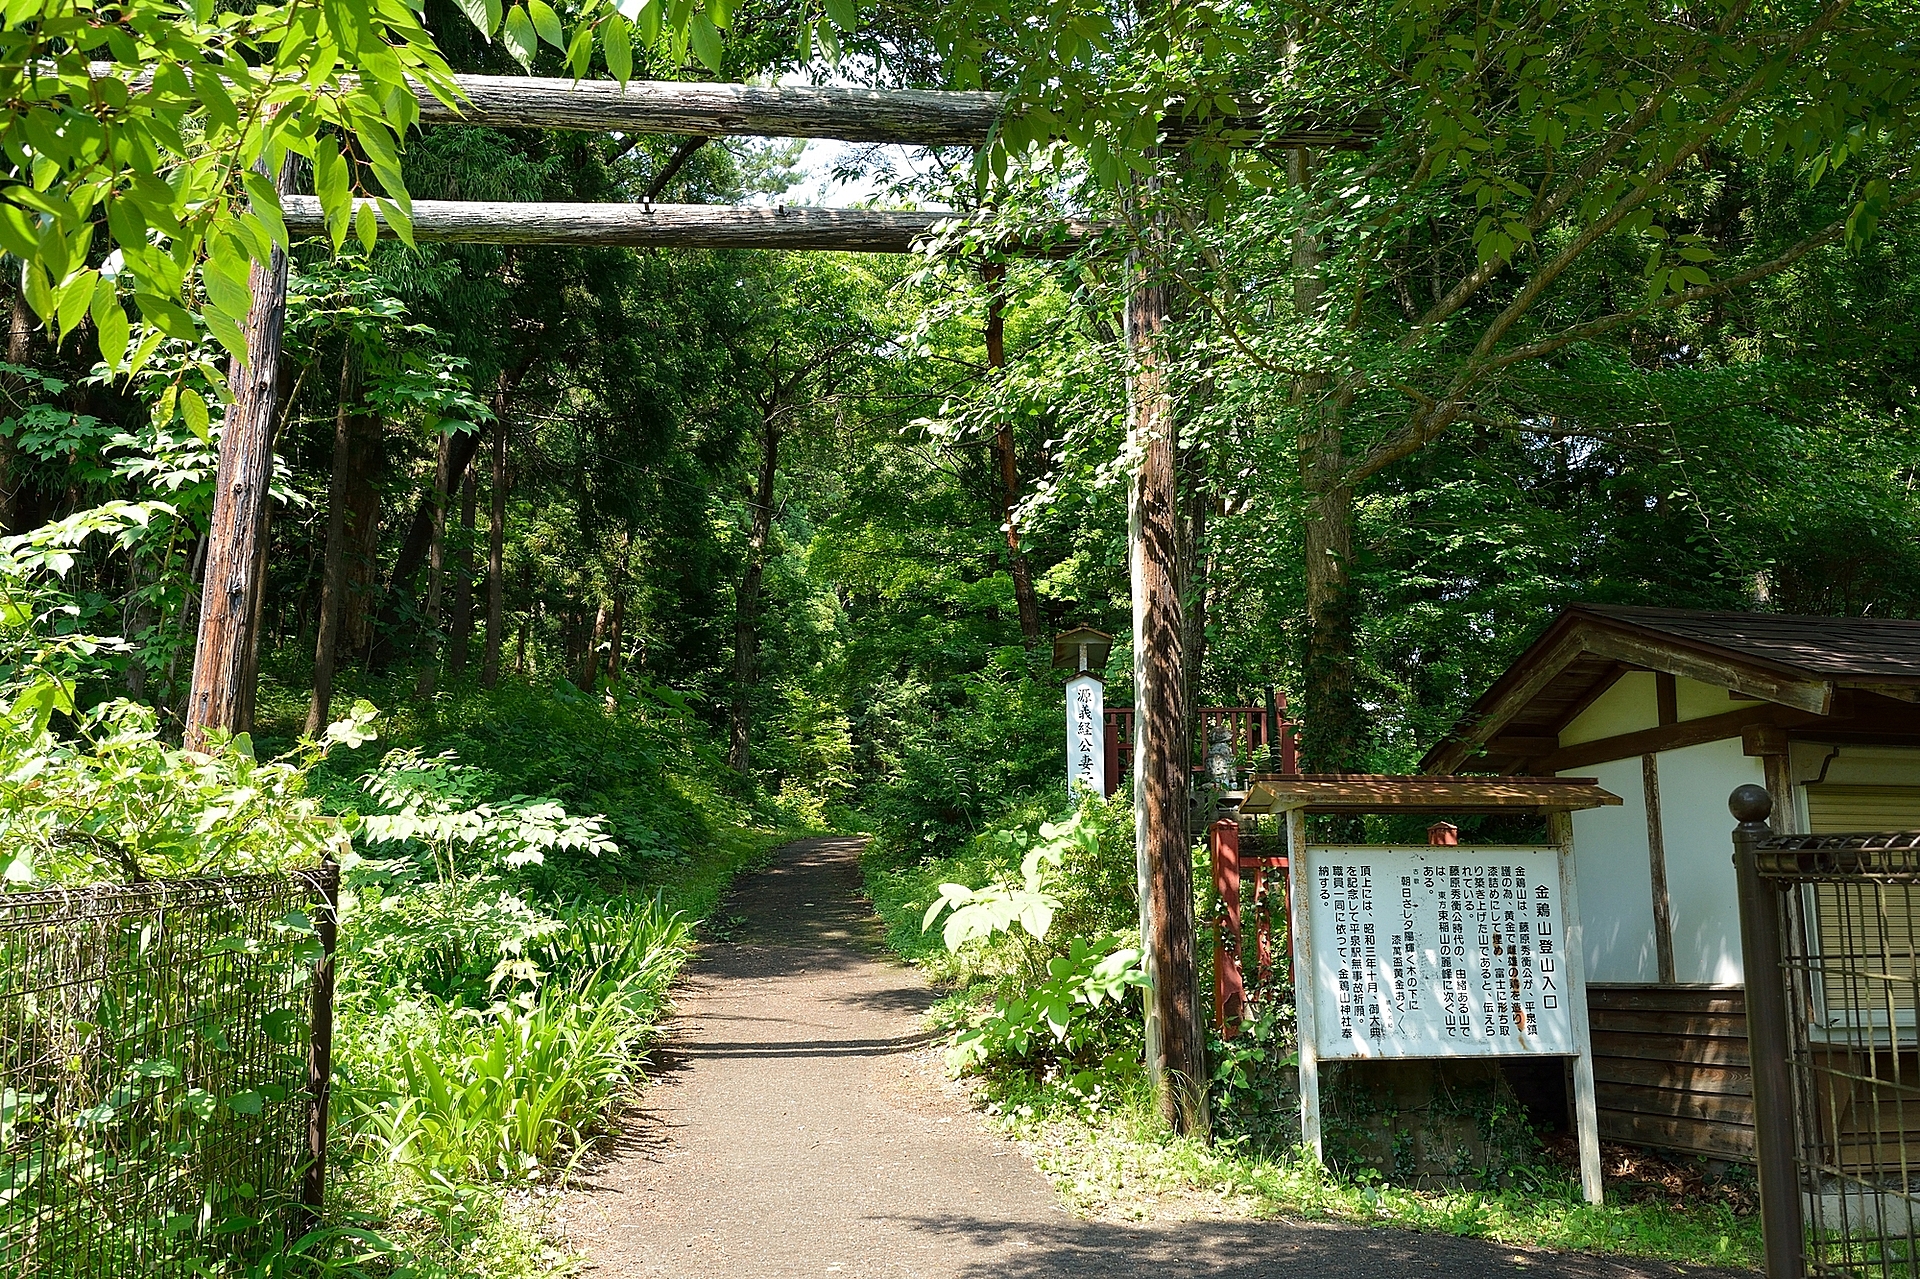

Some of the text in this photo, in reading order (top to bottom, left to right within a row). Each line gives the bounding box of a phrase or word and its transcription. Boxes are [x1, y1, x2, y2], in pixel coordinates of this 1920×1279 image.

[1318, 866, 1330, 907] 納する。
[1346, 866, 1365, 1025] を記念して平泉駅無事故祈願。
[1401, 876, 1418, 1010] 朝日さし夕陽輝く木の下に
[1423, 866, 1434, 895] ある。
[1462, 866, 1475, 920] れている。
[1534, 885, 1557, 1010] 金鶏山登山入口
[1361, 866, 1380, 1038] 頂上には、昭和三年十月、御大典
[1449, 866, 1470, 1037] 藤原秀衡公時代の、由緒ある山で
[1474, 866, 1496, 1037] り築き上げた山であると、伝えら
